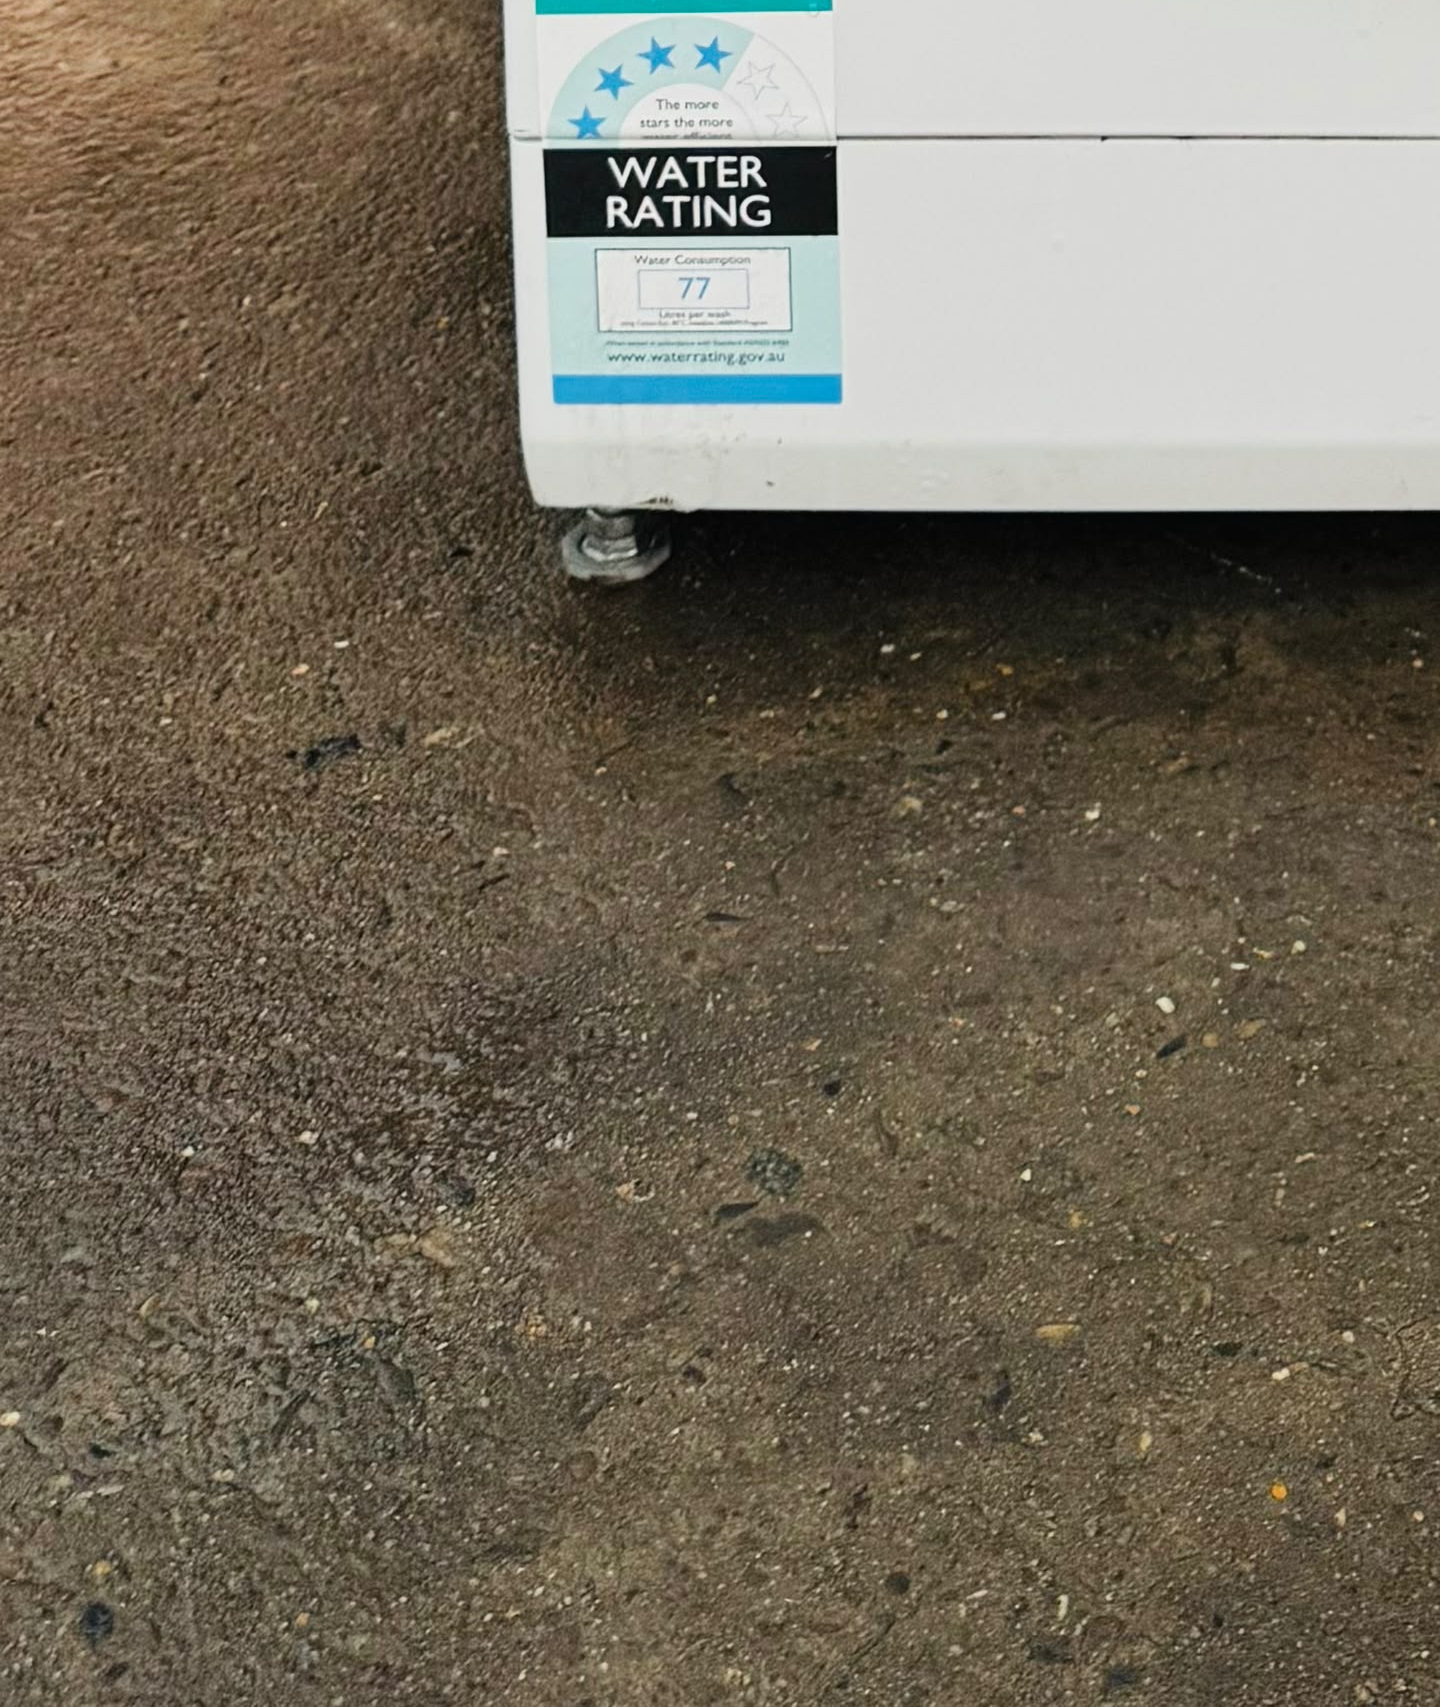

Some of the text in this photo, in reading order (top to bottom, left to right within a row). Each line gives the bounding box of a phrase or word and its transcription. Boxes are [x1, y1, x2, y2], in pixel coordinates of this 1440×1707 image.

[656, 99, 719, 110] The more
[640, 117, 733, 128] stars the more
[607, 155, 768, 190] WATER
[606, 194, 771, 229] RATING
[634, 254, 751, 266] Water Consumption
[678, 277, 711, 300] 77
[688, 312, 704, 321] per
[607, 351, 785, 366] www.waterrating.gov.au
